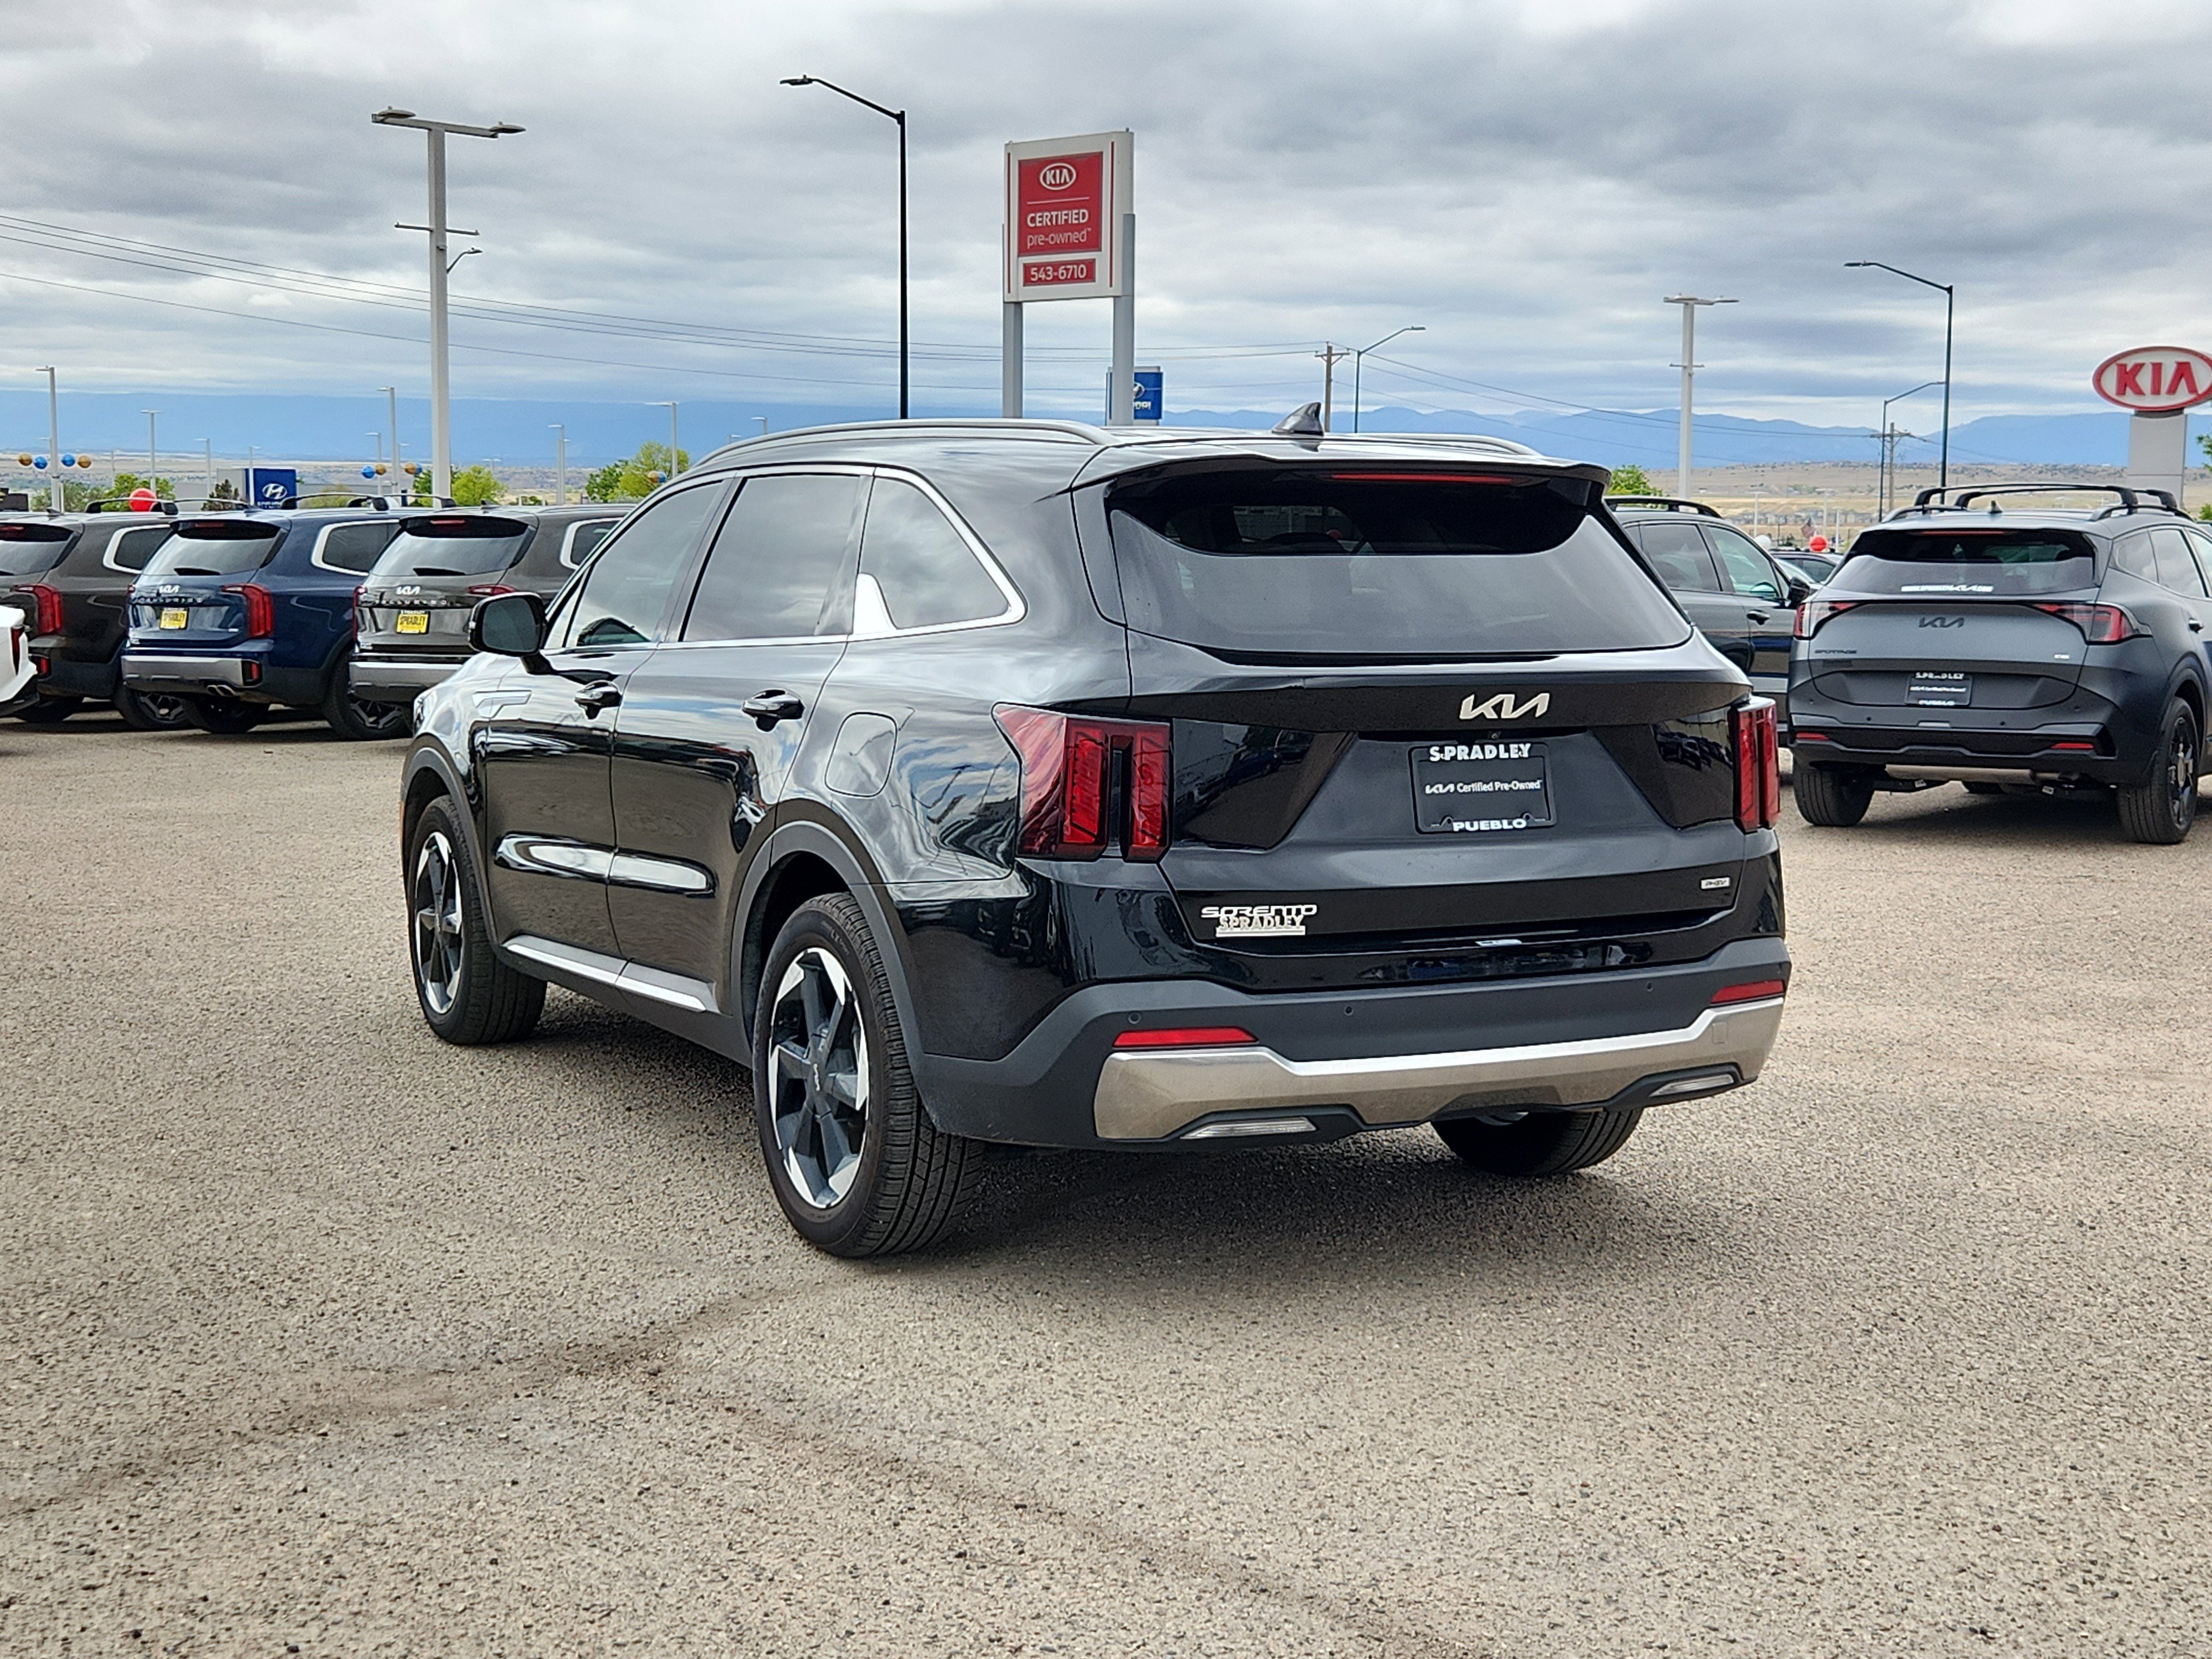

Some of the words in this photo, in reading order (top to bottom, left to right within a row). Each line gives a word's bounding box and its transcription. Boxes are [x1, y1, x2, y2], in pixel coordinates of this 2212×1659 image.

[1046, 169, 1071, 185] KIA
[1027, 209, 1089, 227] CERTIFIED
[1030, 264, 1087, 281] 543-6710
[2115, 361, 2199, 395] KIA
[159, 584, 181, 594] KIA
[396, 586, 421, 595] KIA
[1919, 616, 1965, 628] KIA
[1459, 693, 1550, 720] KIA
[1430, 743, 1531, 762] SPRADLEY
[1425, 783, 1455, 794] KIA
[1456, 781, 1493, 793] Certified
[1453, 819, 1527, 832] PUEBLO
[1200, 905, 1317, 918] SORENTO
[1219, 914, 1304, 930] SPRADLEY
